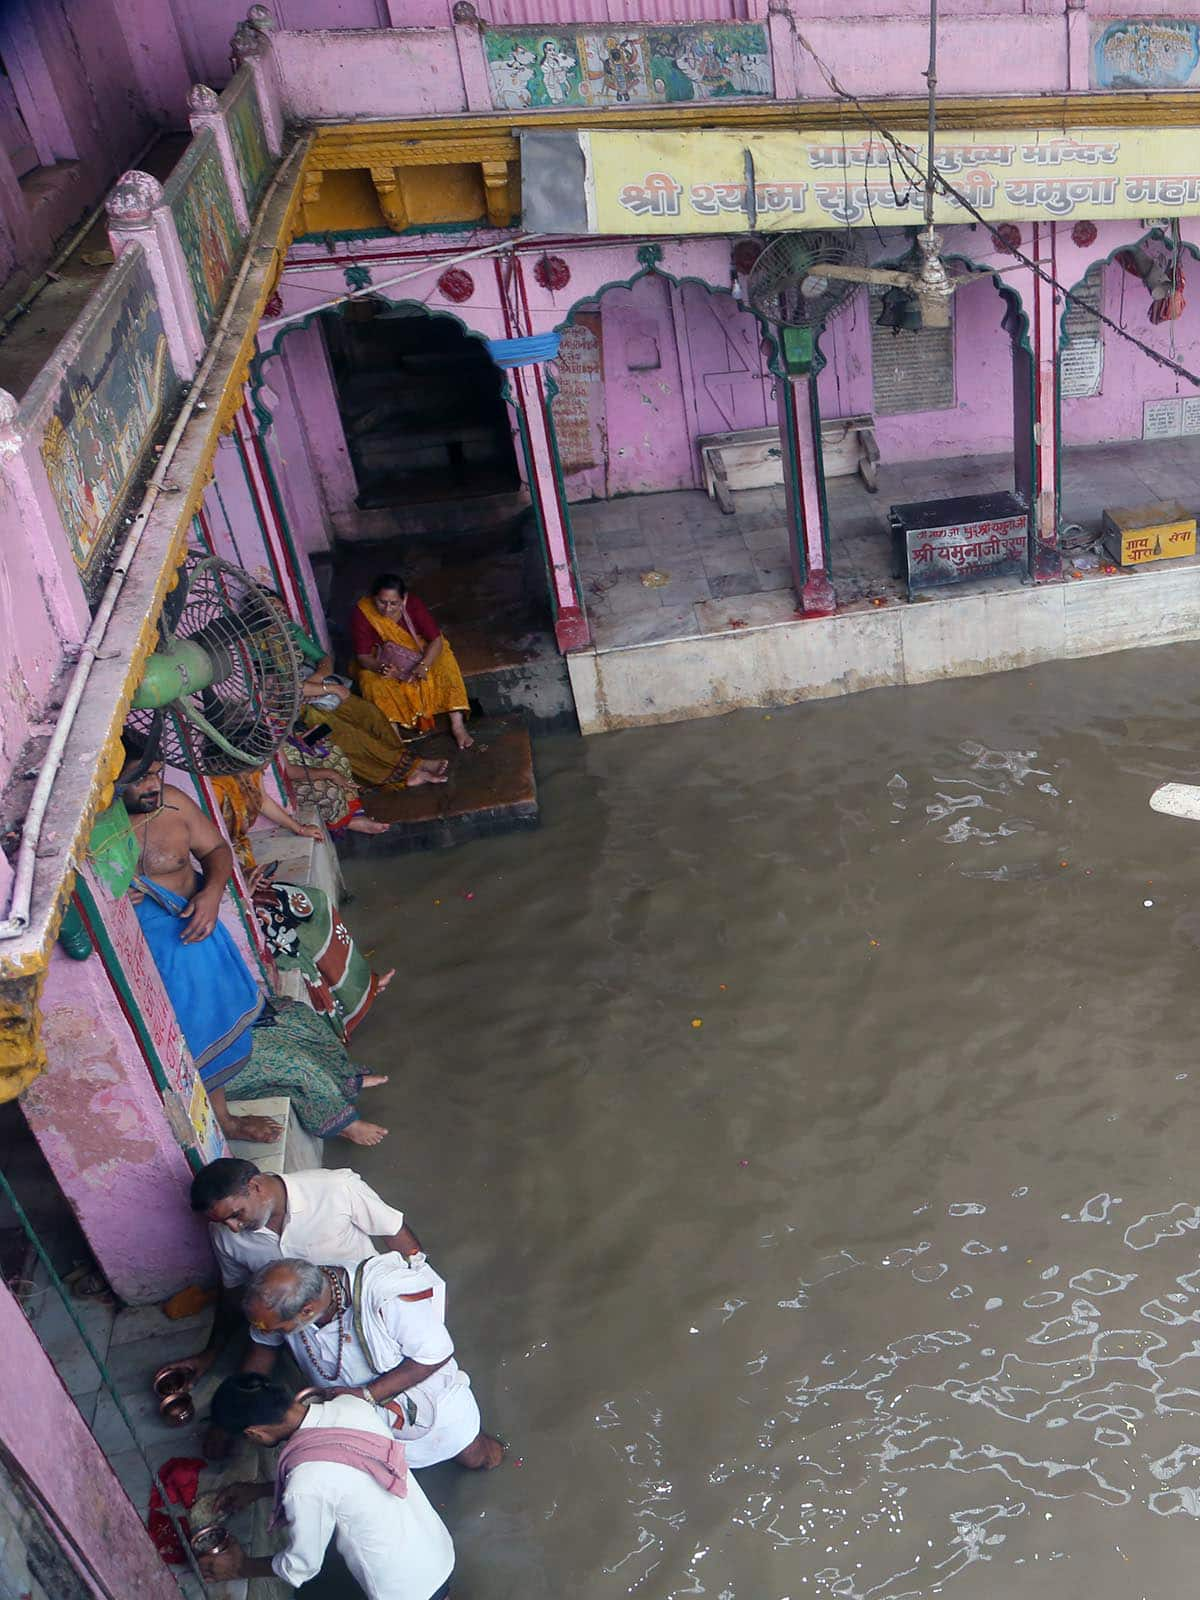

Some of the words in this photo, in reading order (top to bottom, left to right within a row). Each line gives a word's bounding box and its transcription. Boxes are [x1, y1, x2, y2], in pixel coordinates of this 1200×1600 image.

[807, 139, 923, 168] प्राचीन
[1019, 138, 1120, 166] मन्दिर
[619, 172, 682, 216] श्री
[688, 181, 807, 214] श्याम
[944, 169, 999, 208] श्री
[1004, 175, 1119, 215] यमुना
[912, 542, 934, 564] श्री
[1125, 537, 1149, 551] गाय
[1169, 530, 1192, 544] सेवा
